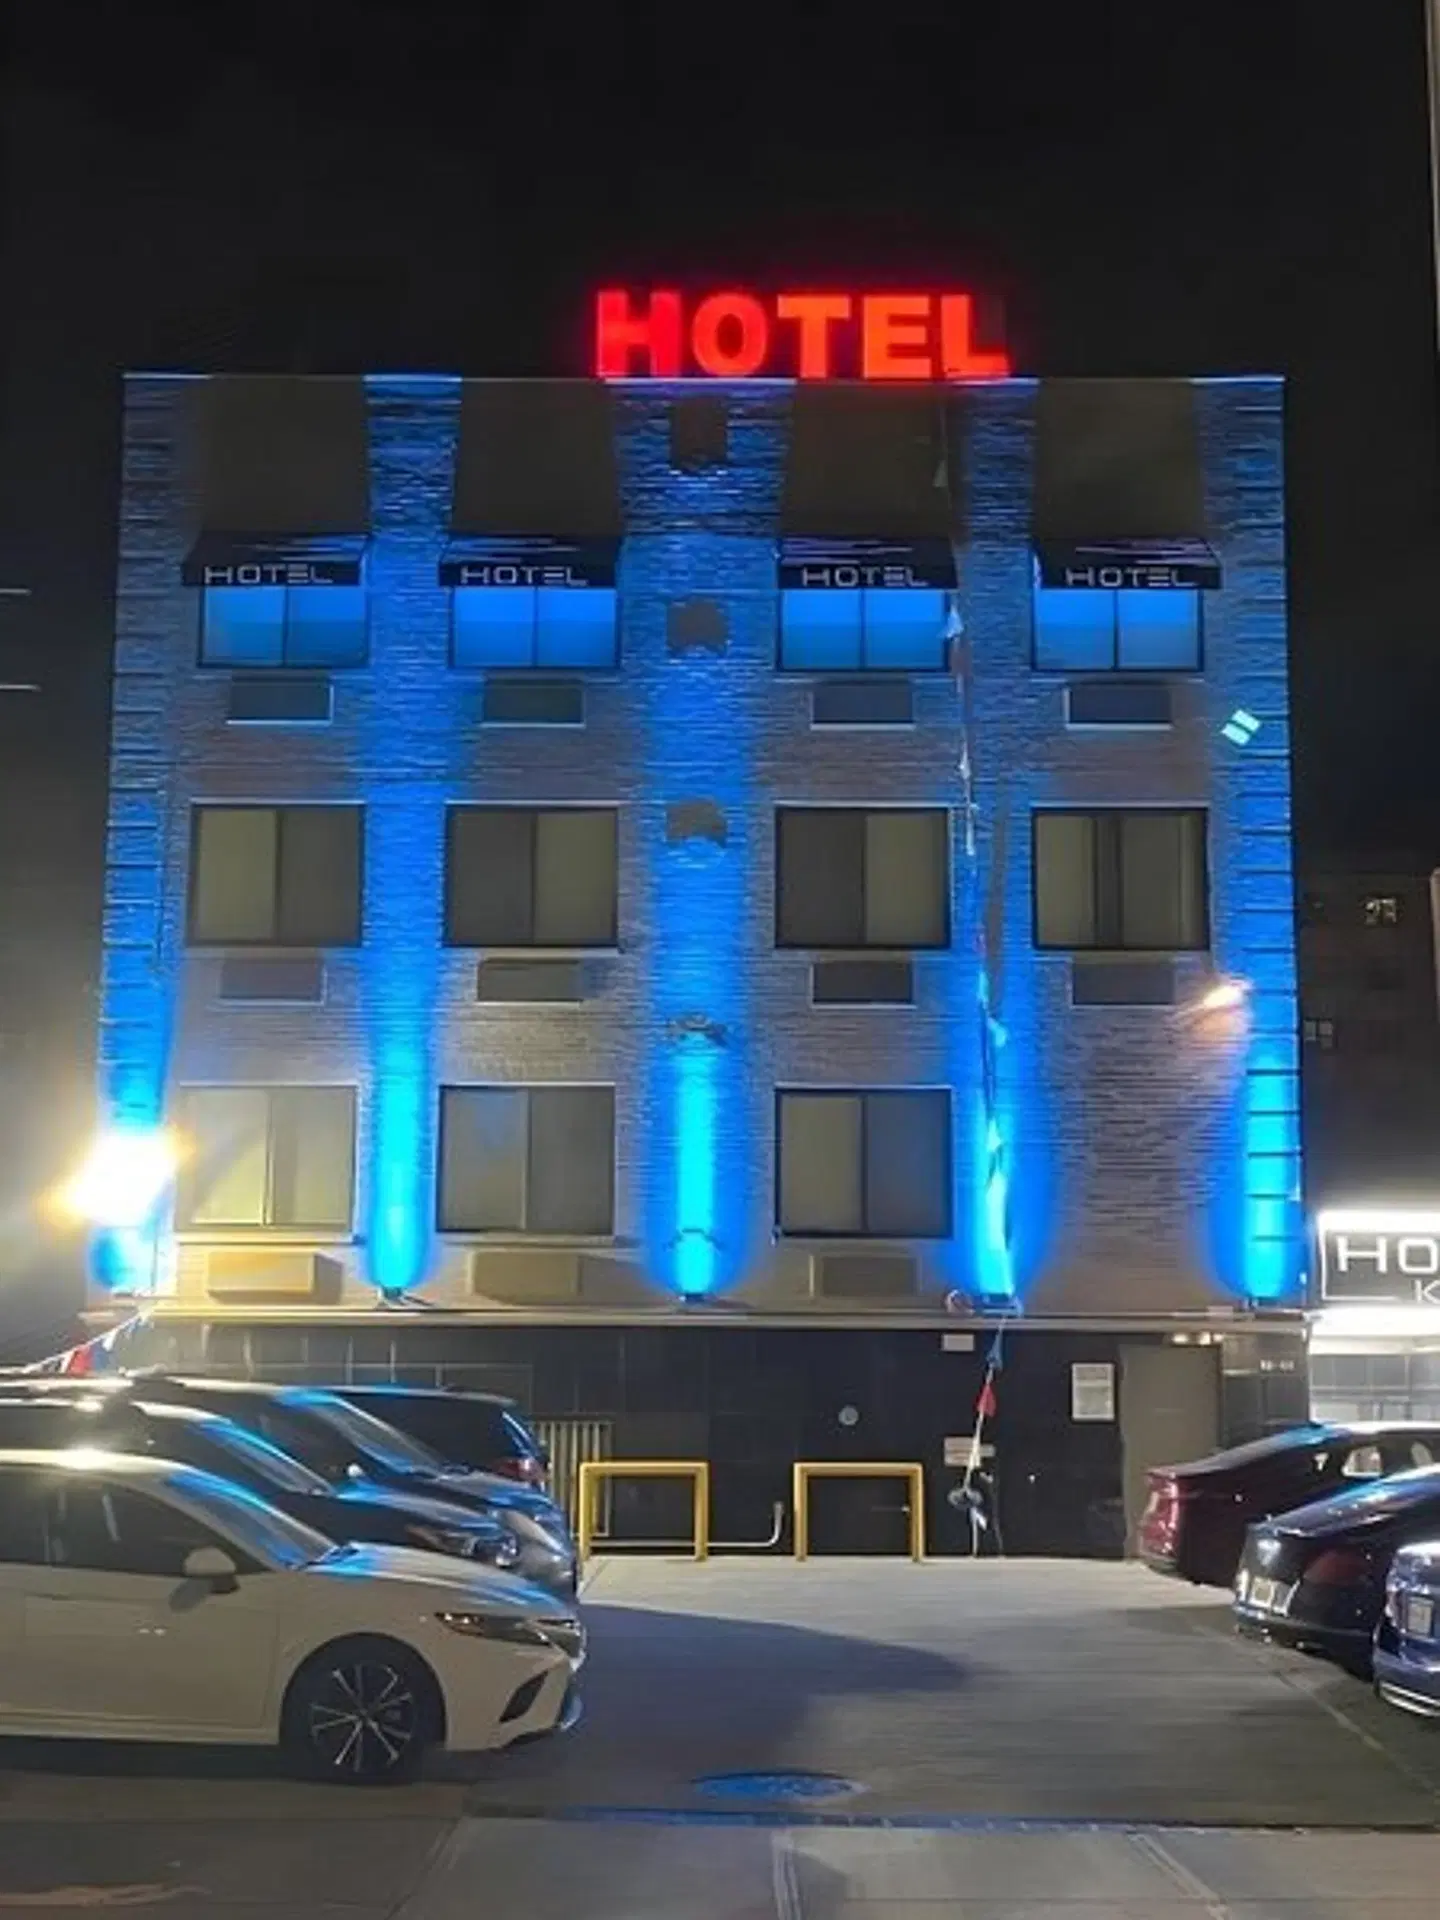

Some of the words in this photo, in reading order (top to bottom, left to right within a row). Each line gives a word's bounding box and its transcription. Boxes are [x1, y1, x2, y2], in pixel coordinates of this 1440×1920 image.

[596, 290, 1010, 379] HOTEL
[204, 565, 333, 584] HOTEL
[461, 566, 588, 586] HOTEL
[802, 567, 928, 586] HOTEL
[1066, 567, 1195, 587] HOTEL
